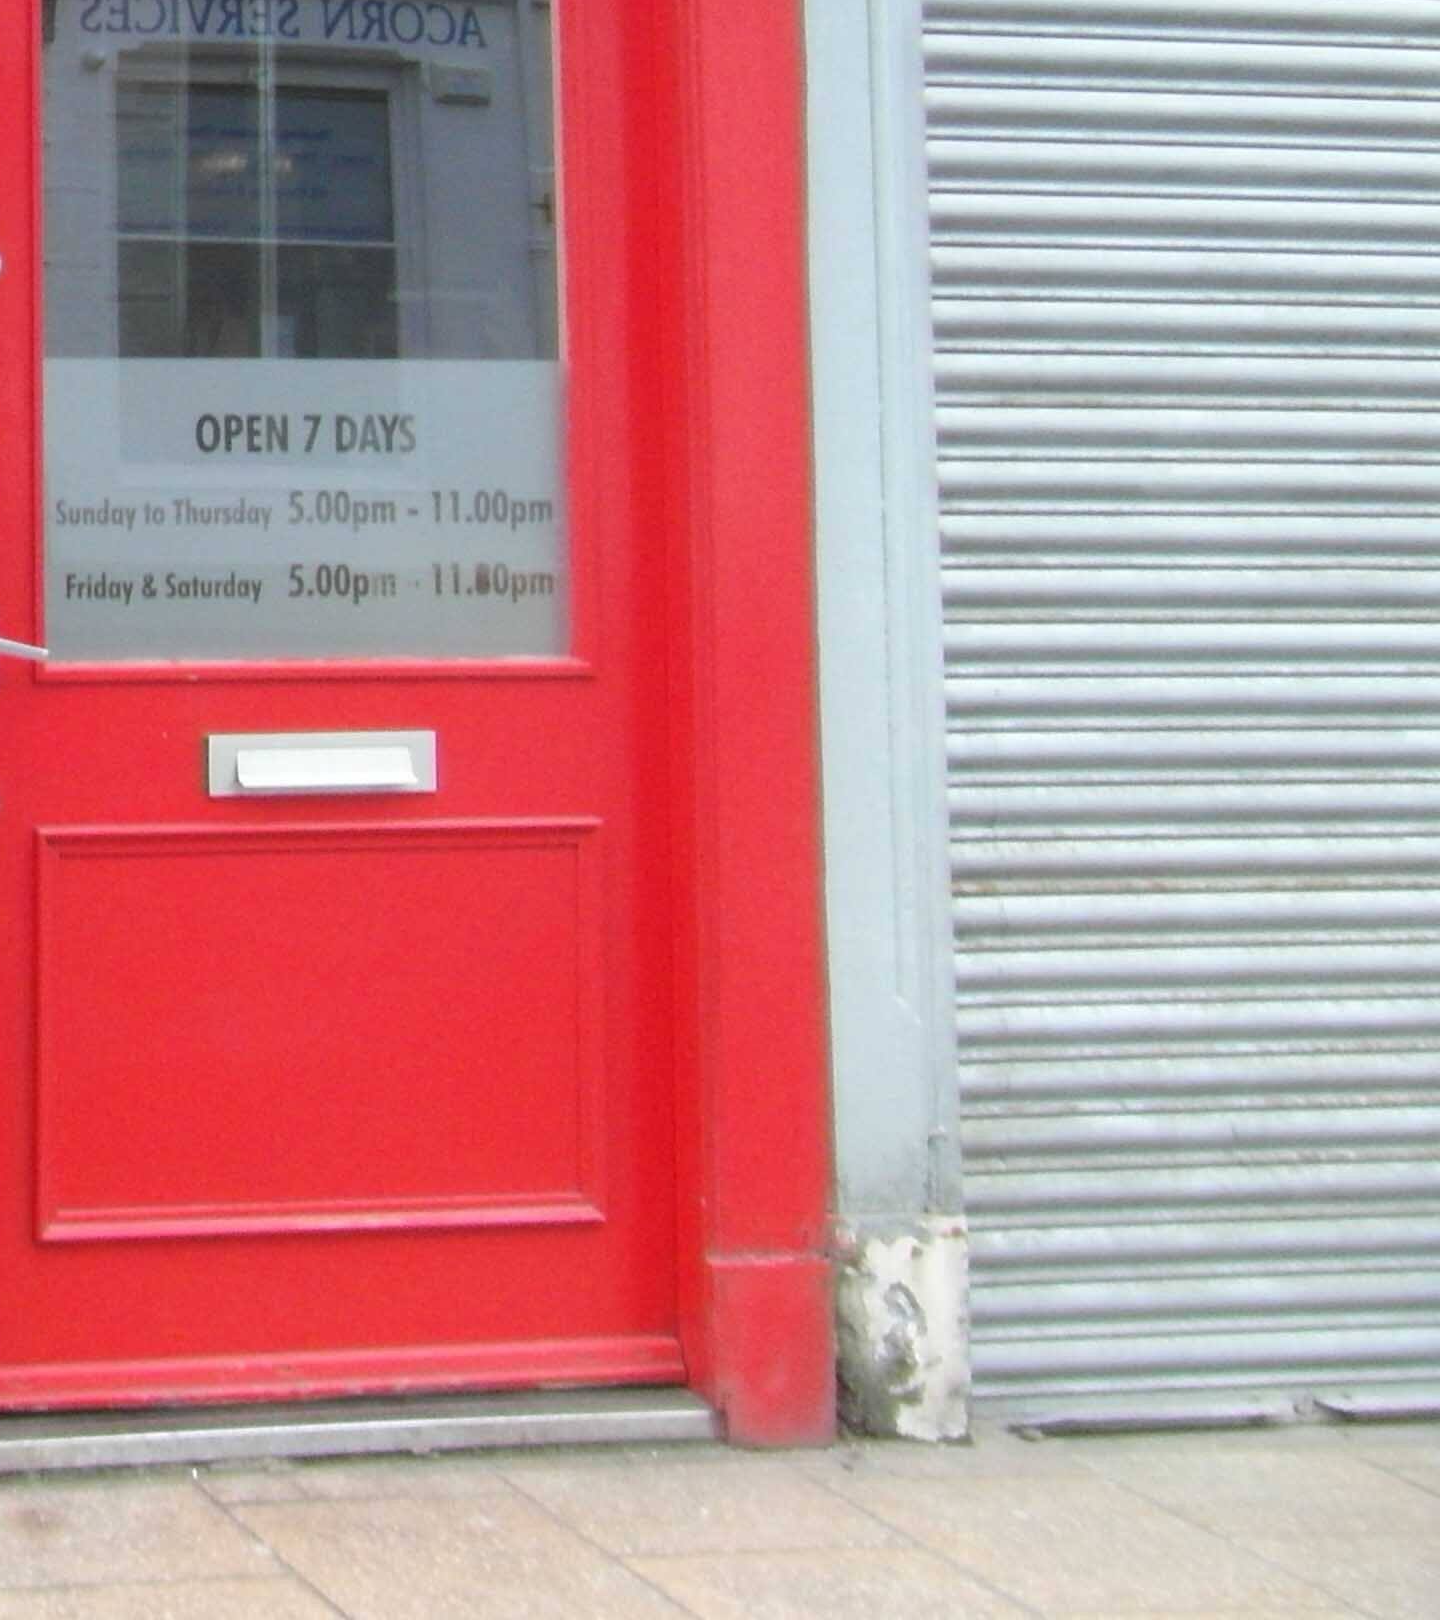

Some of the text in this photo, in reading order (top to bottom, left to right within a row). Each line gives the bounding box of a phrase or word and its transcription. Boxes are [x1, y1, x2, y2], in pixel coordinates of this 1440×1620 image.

[194, 413, 417, 454] OPEN 7 DAYS
[54, 498, 137, 532] Sunday
[143, 501, 166, 526] to
[172, 499, 272, 531] Thursday
[287, 490, 397, 533] 5.00pm
[430, 490, 554, 532] 11.00pm
[64, 572, 133, 606] Friday
[140, 574, 158, 599] &
[164, 572, 263, 606] Saturday
[287, 564, 398, 606] 5.00pm
